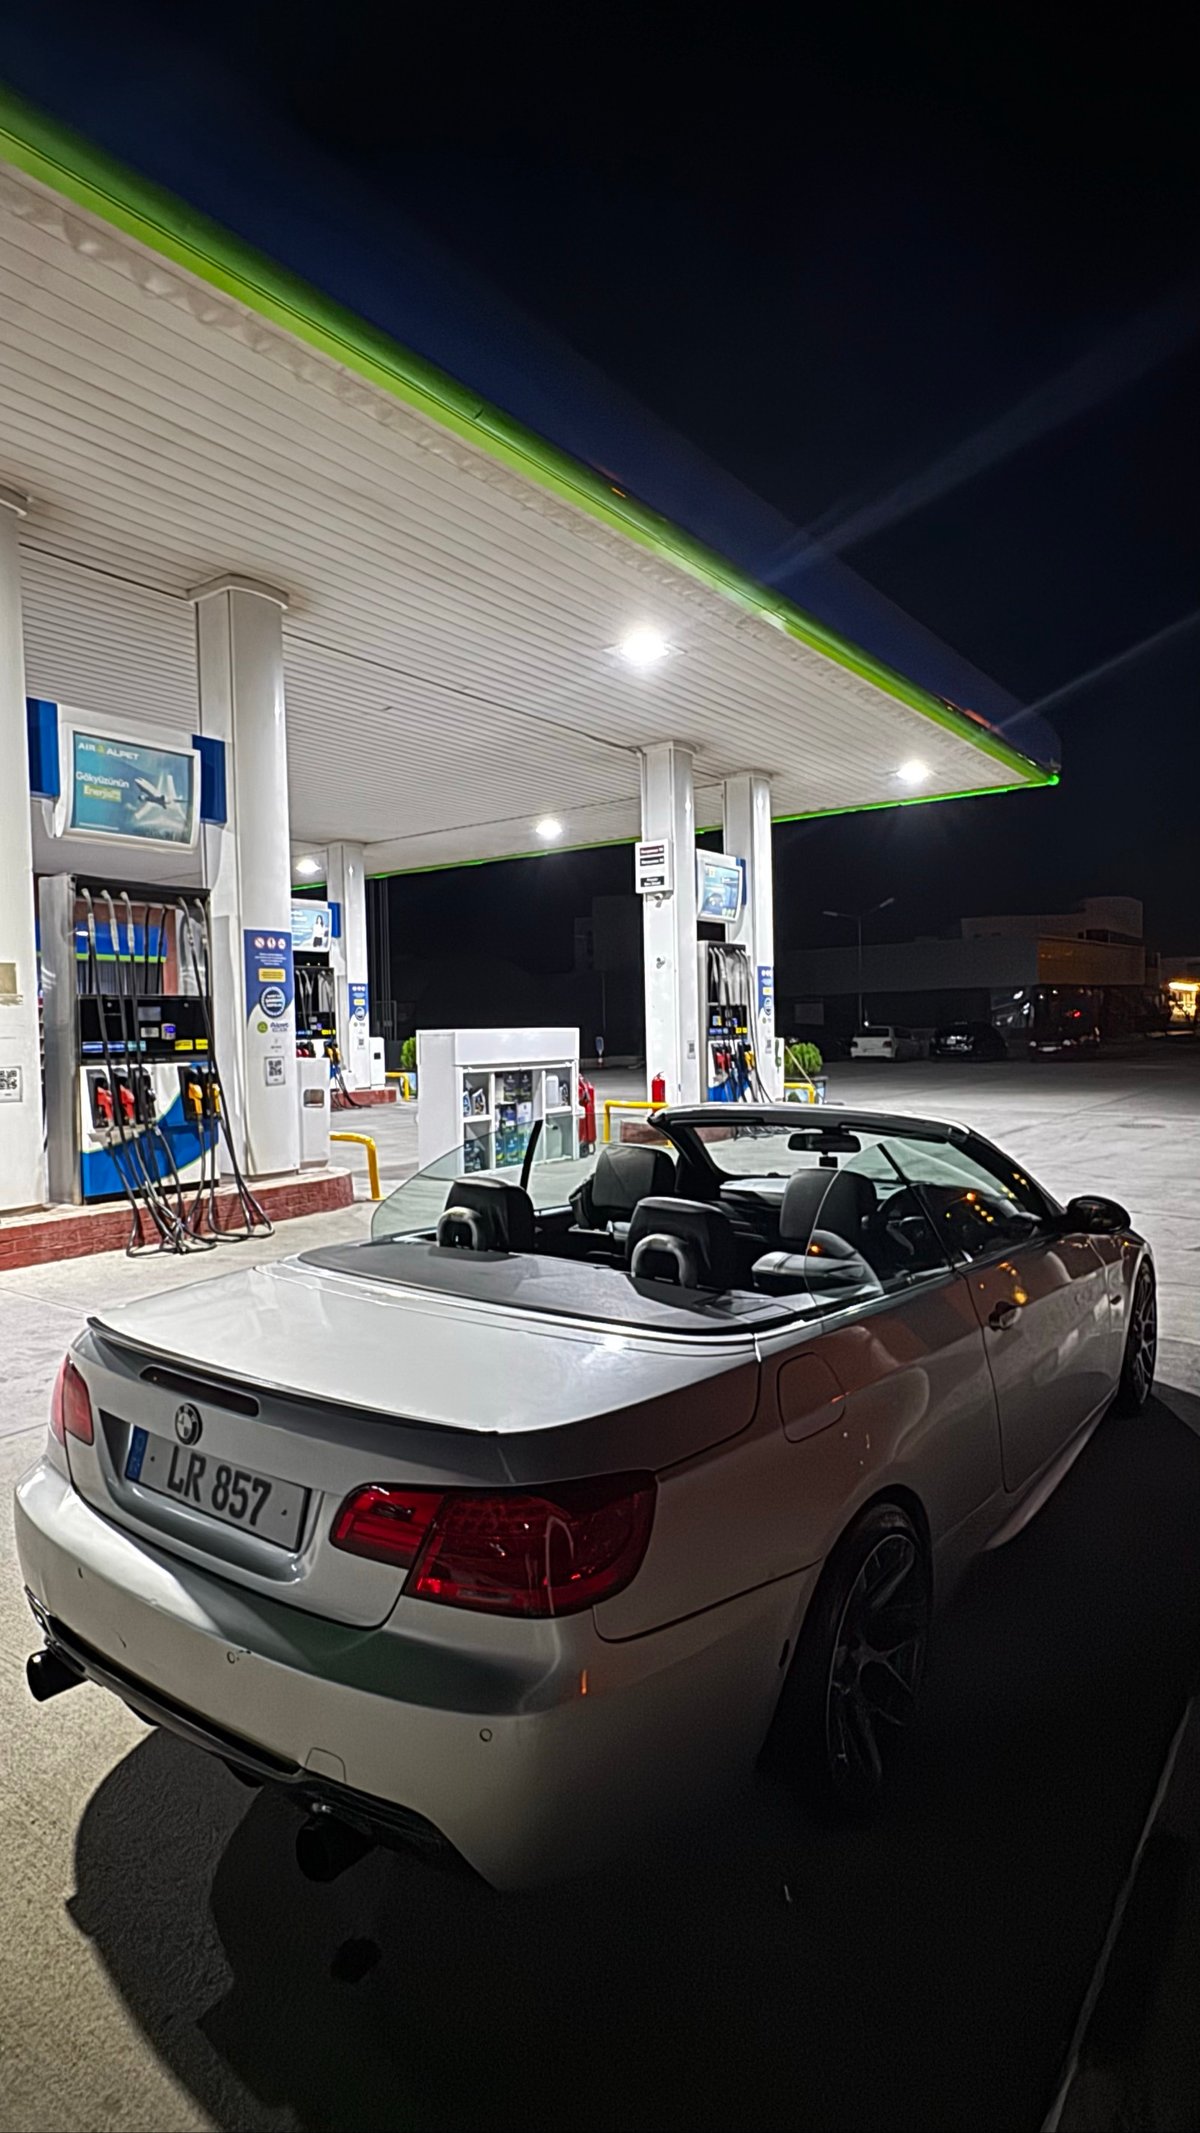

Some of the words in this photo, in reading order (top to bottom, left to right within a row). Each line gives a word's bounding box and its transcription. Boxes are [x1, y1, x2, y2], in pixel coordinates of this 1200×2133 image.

[78, 742, 96, 752] AIR
[106, 748, 140, 761] ALPET
[167, 1445, 206, 1503] LR
[211, 1464, 272, 1527] 857
